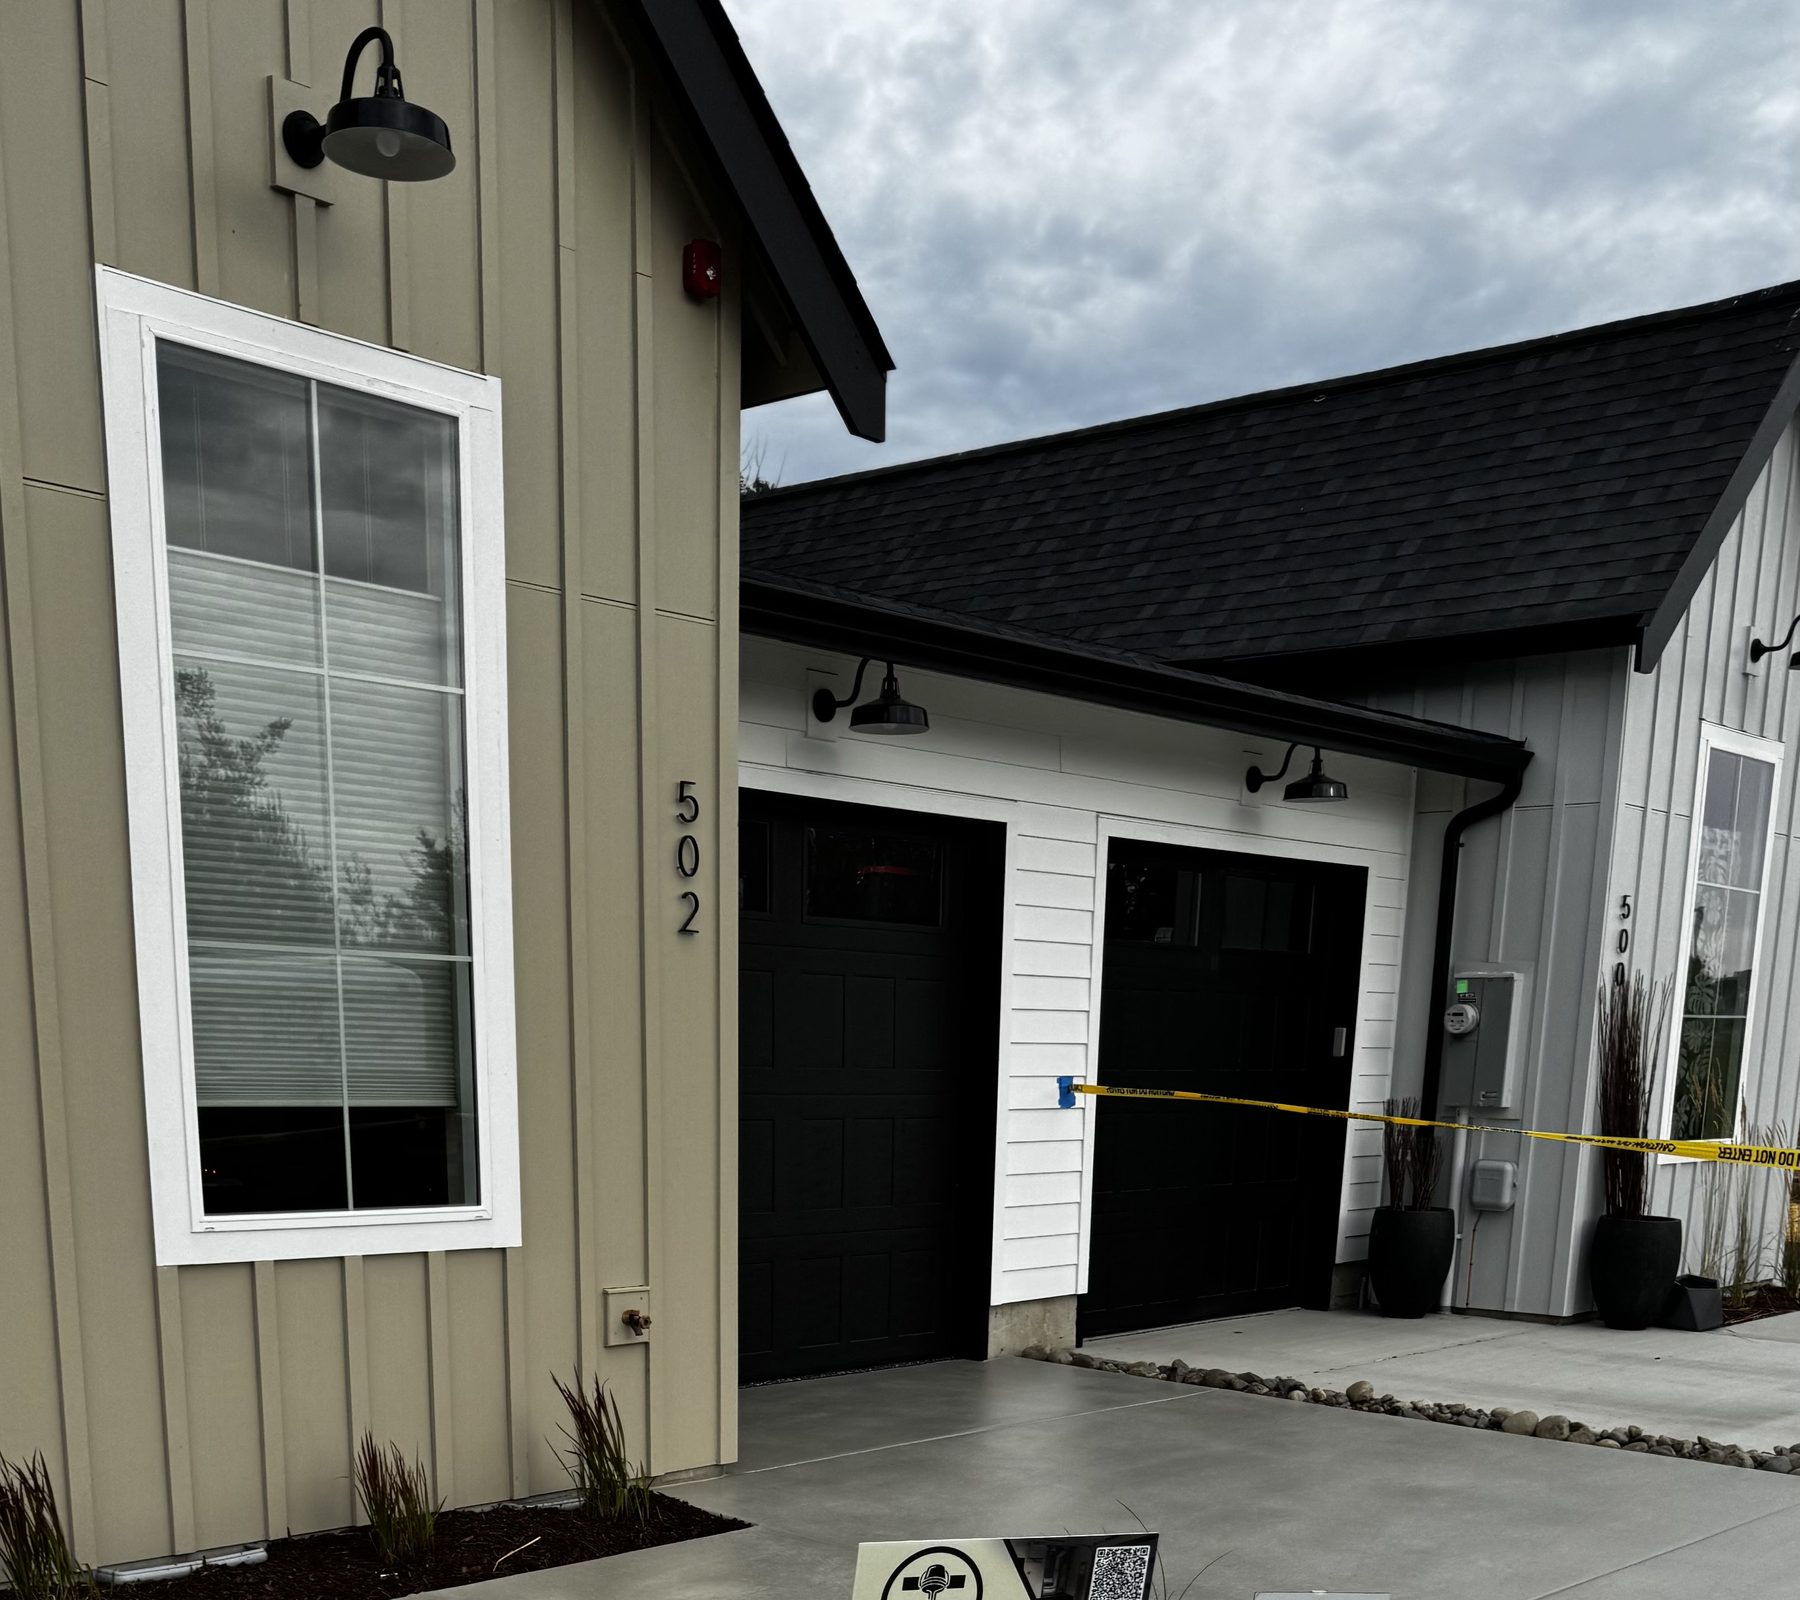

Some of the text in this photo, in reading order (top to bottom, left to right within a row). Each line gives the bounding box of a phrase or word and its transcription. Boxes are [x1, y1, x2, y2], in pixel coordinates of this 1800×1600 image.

[676, 780, 700, 934] 502
[1615, 895, 1631, 987] 500
[1718, 1146, 1752, 1162] ENTER
[1753, 1149, 1777, 1166] NOT
[1778, 1151, 1795, 1167] DO
